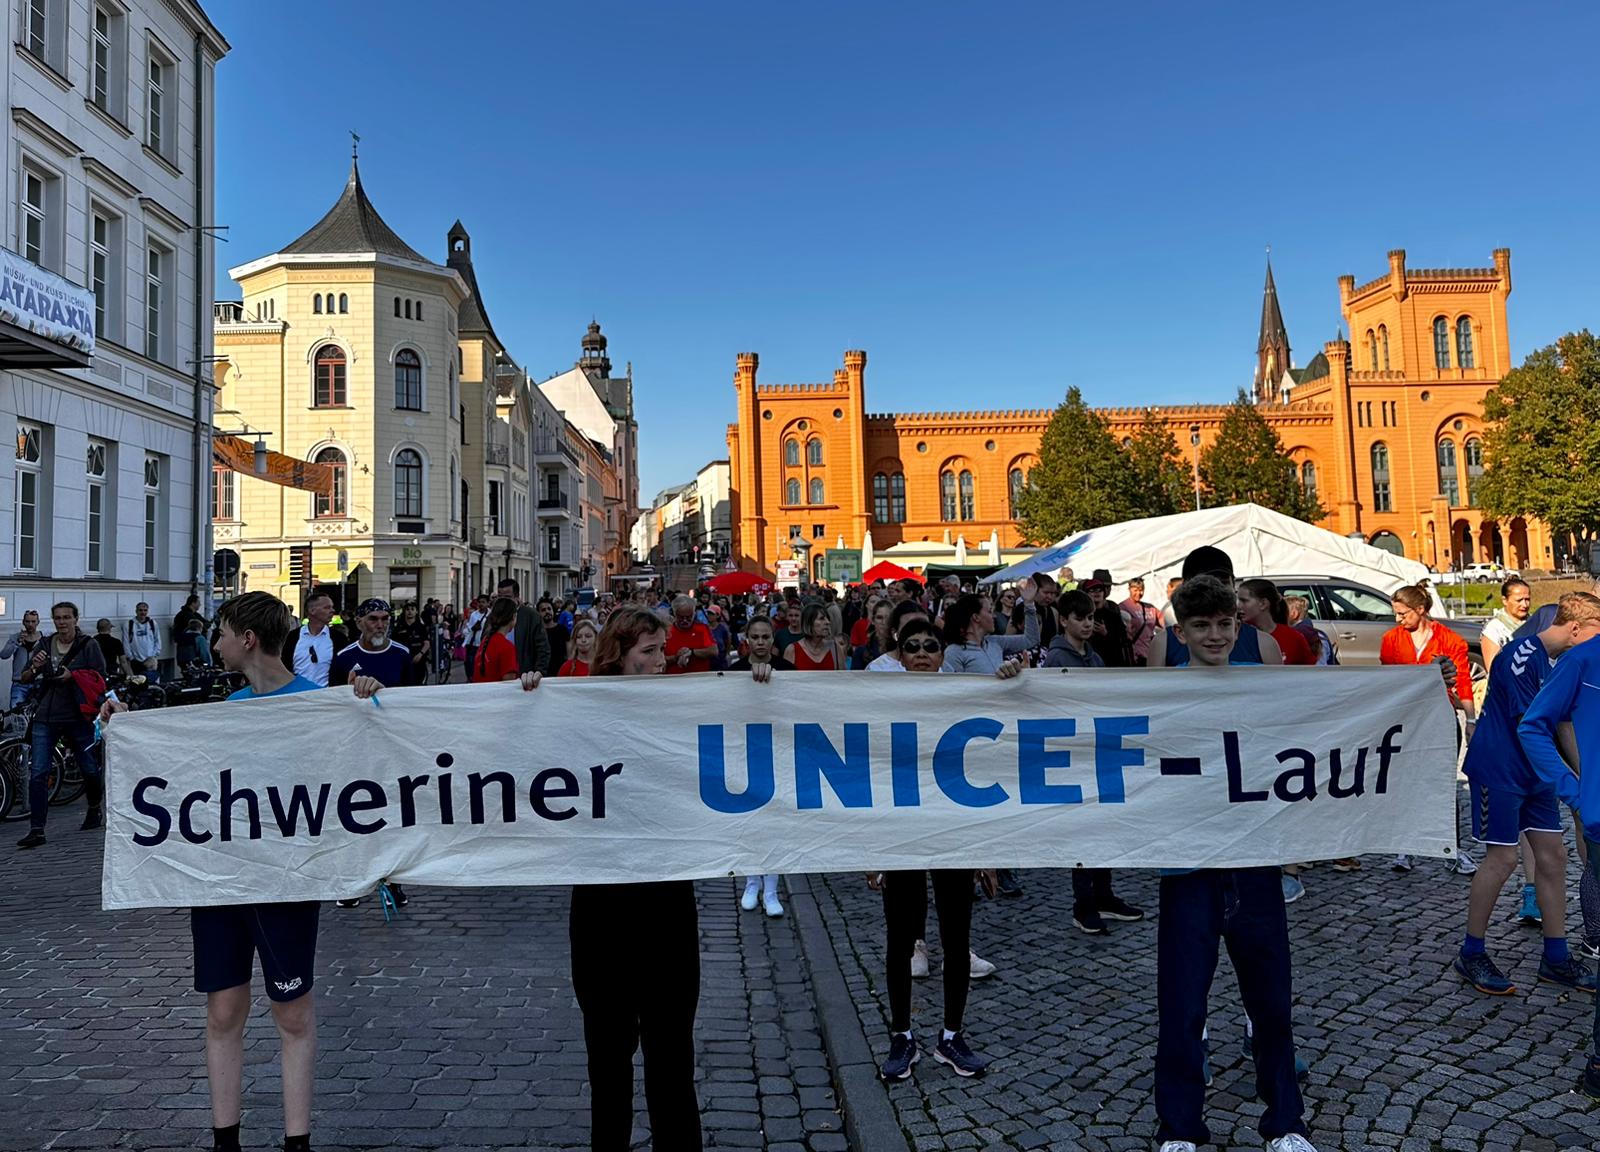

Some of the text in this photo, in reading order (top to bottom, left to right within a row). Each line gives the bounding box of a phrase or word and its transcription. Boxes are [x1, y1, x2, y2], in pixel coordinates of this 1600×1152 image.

[0, 276, 94, 339] ATARAXIA
[4, 265, 28, 284] MUSIK-
[30, 279, 44, 291] UND
[132, 715, 1405, 847] Schweriner UNICEF-Lauf
